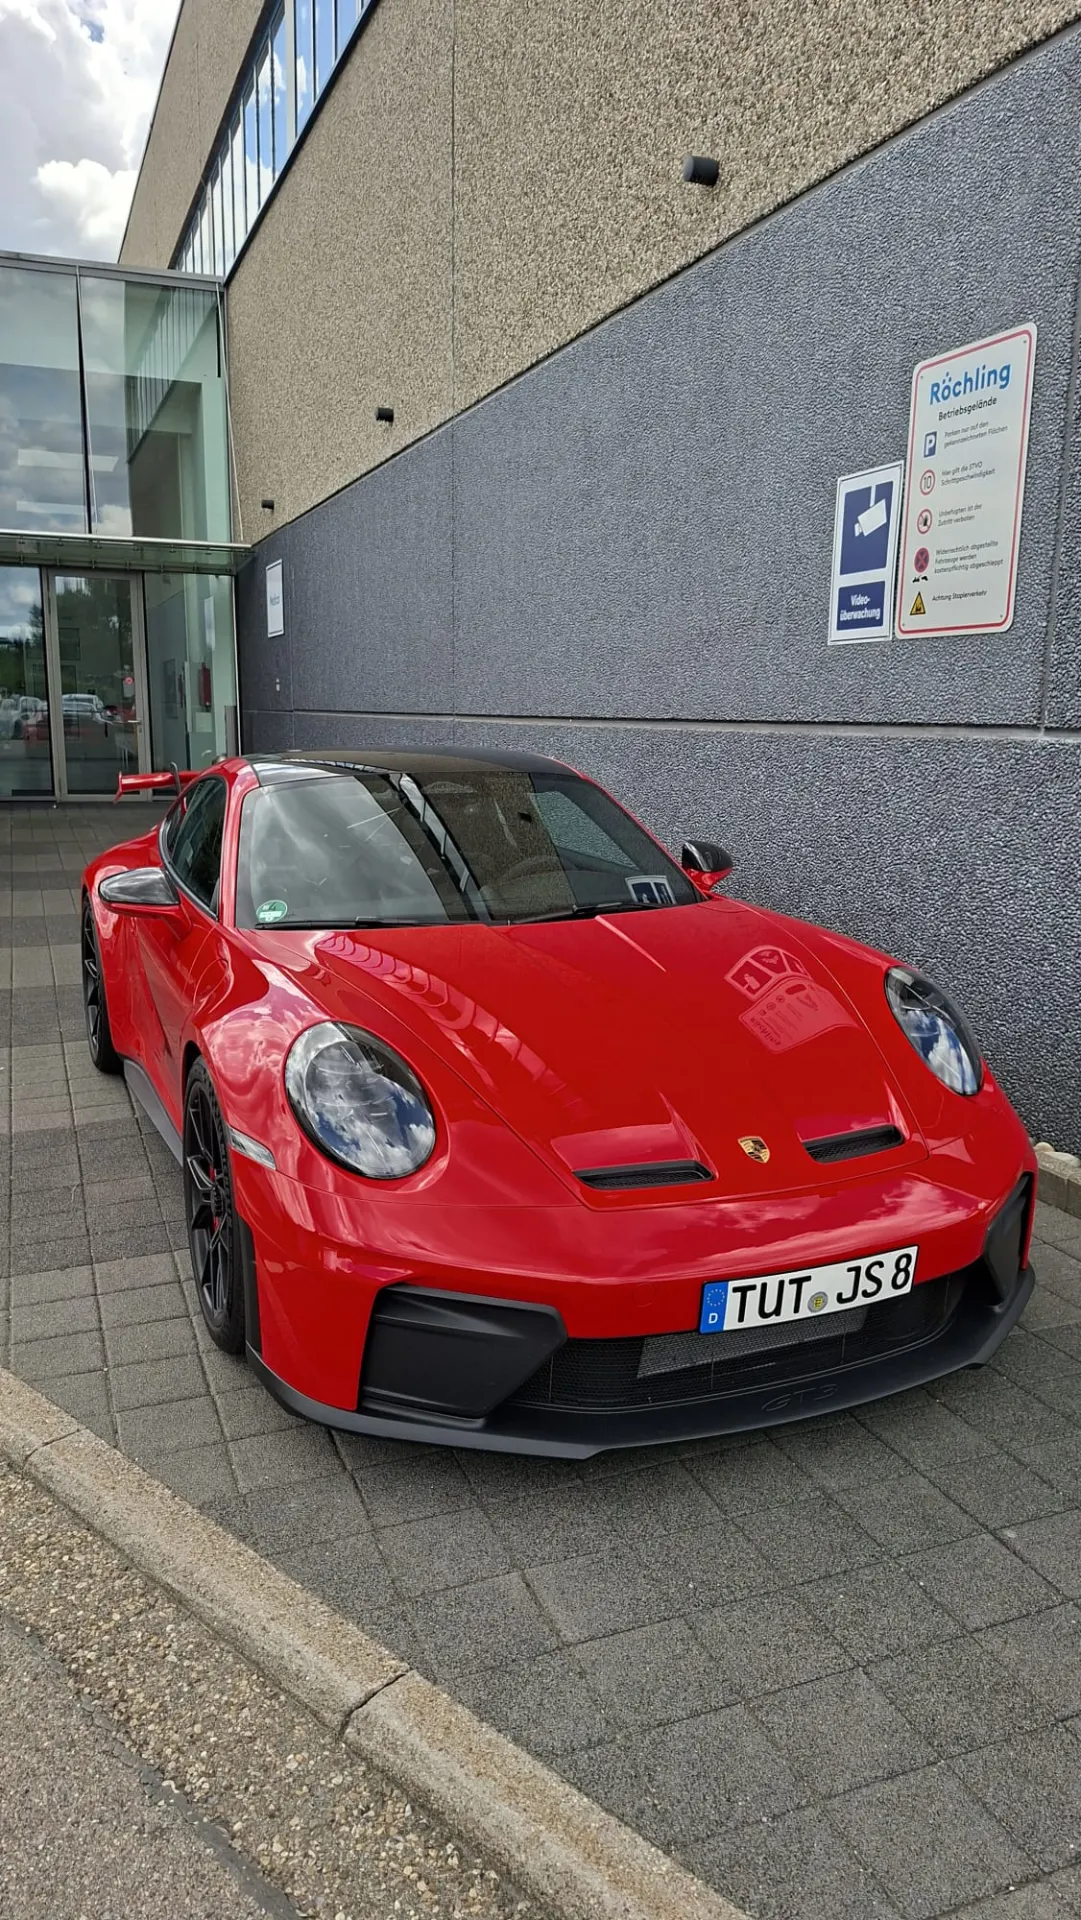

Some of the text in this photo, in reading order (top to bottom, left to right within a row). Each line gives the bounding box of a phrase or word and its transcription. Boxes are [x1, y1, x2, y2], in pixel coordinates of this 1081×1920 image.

[929, 364, 1011, 405] Röchling
[938, 396, 997, 421] Betriebsgelände
[925, 436, 936, 455] P
[923, 475, 932, 490] 10
[850, 593, 871, 606] Video-
[839, 607, 881, 621] überwachung
[731, 1253, 912, 1323] TUT JS 8
[708, 1312, 718, 1324] D
